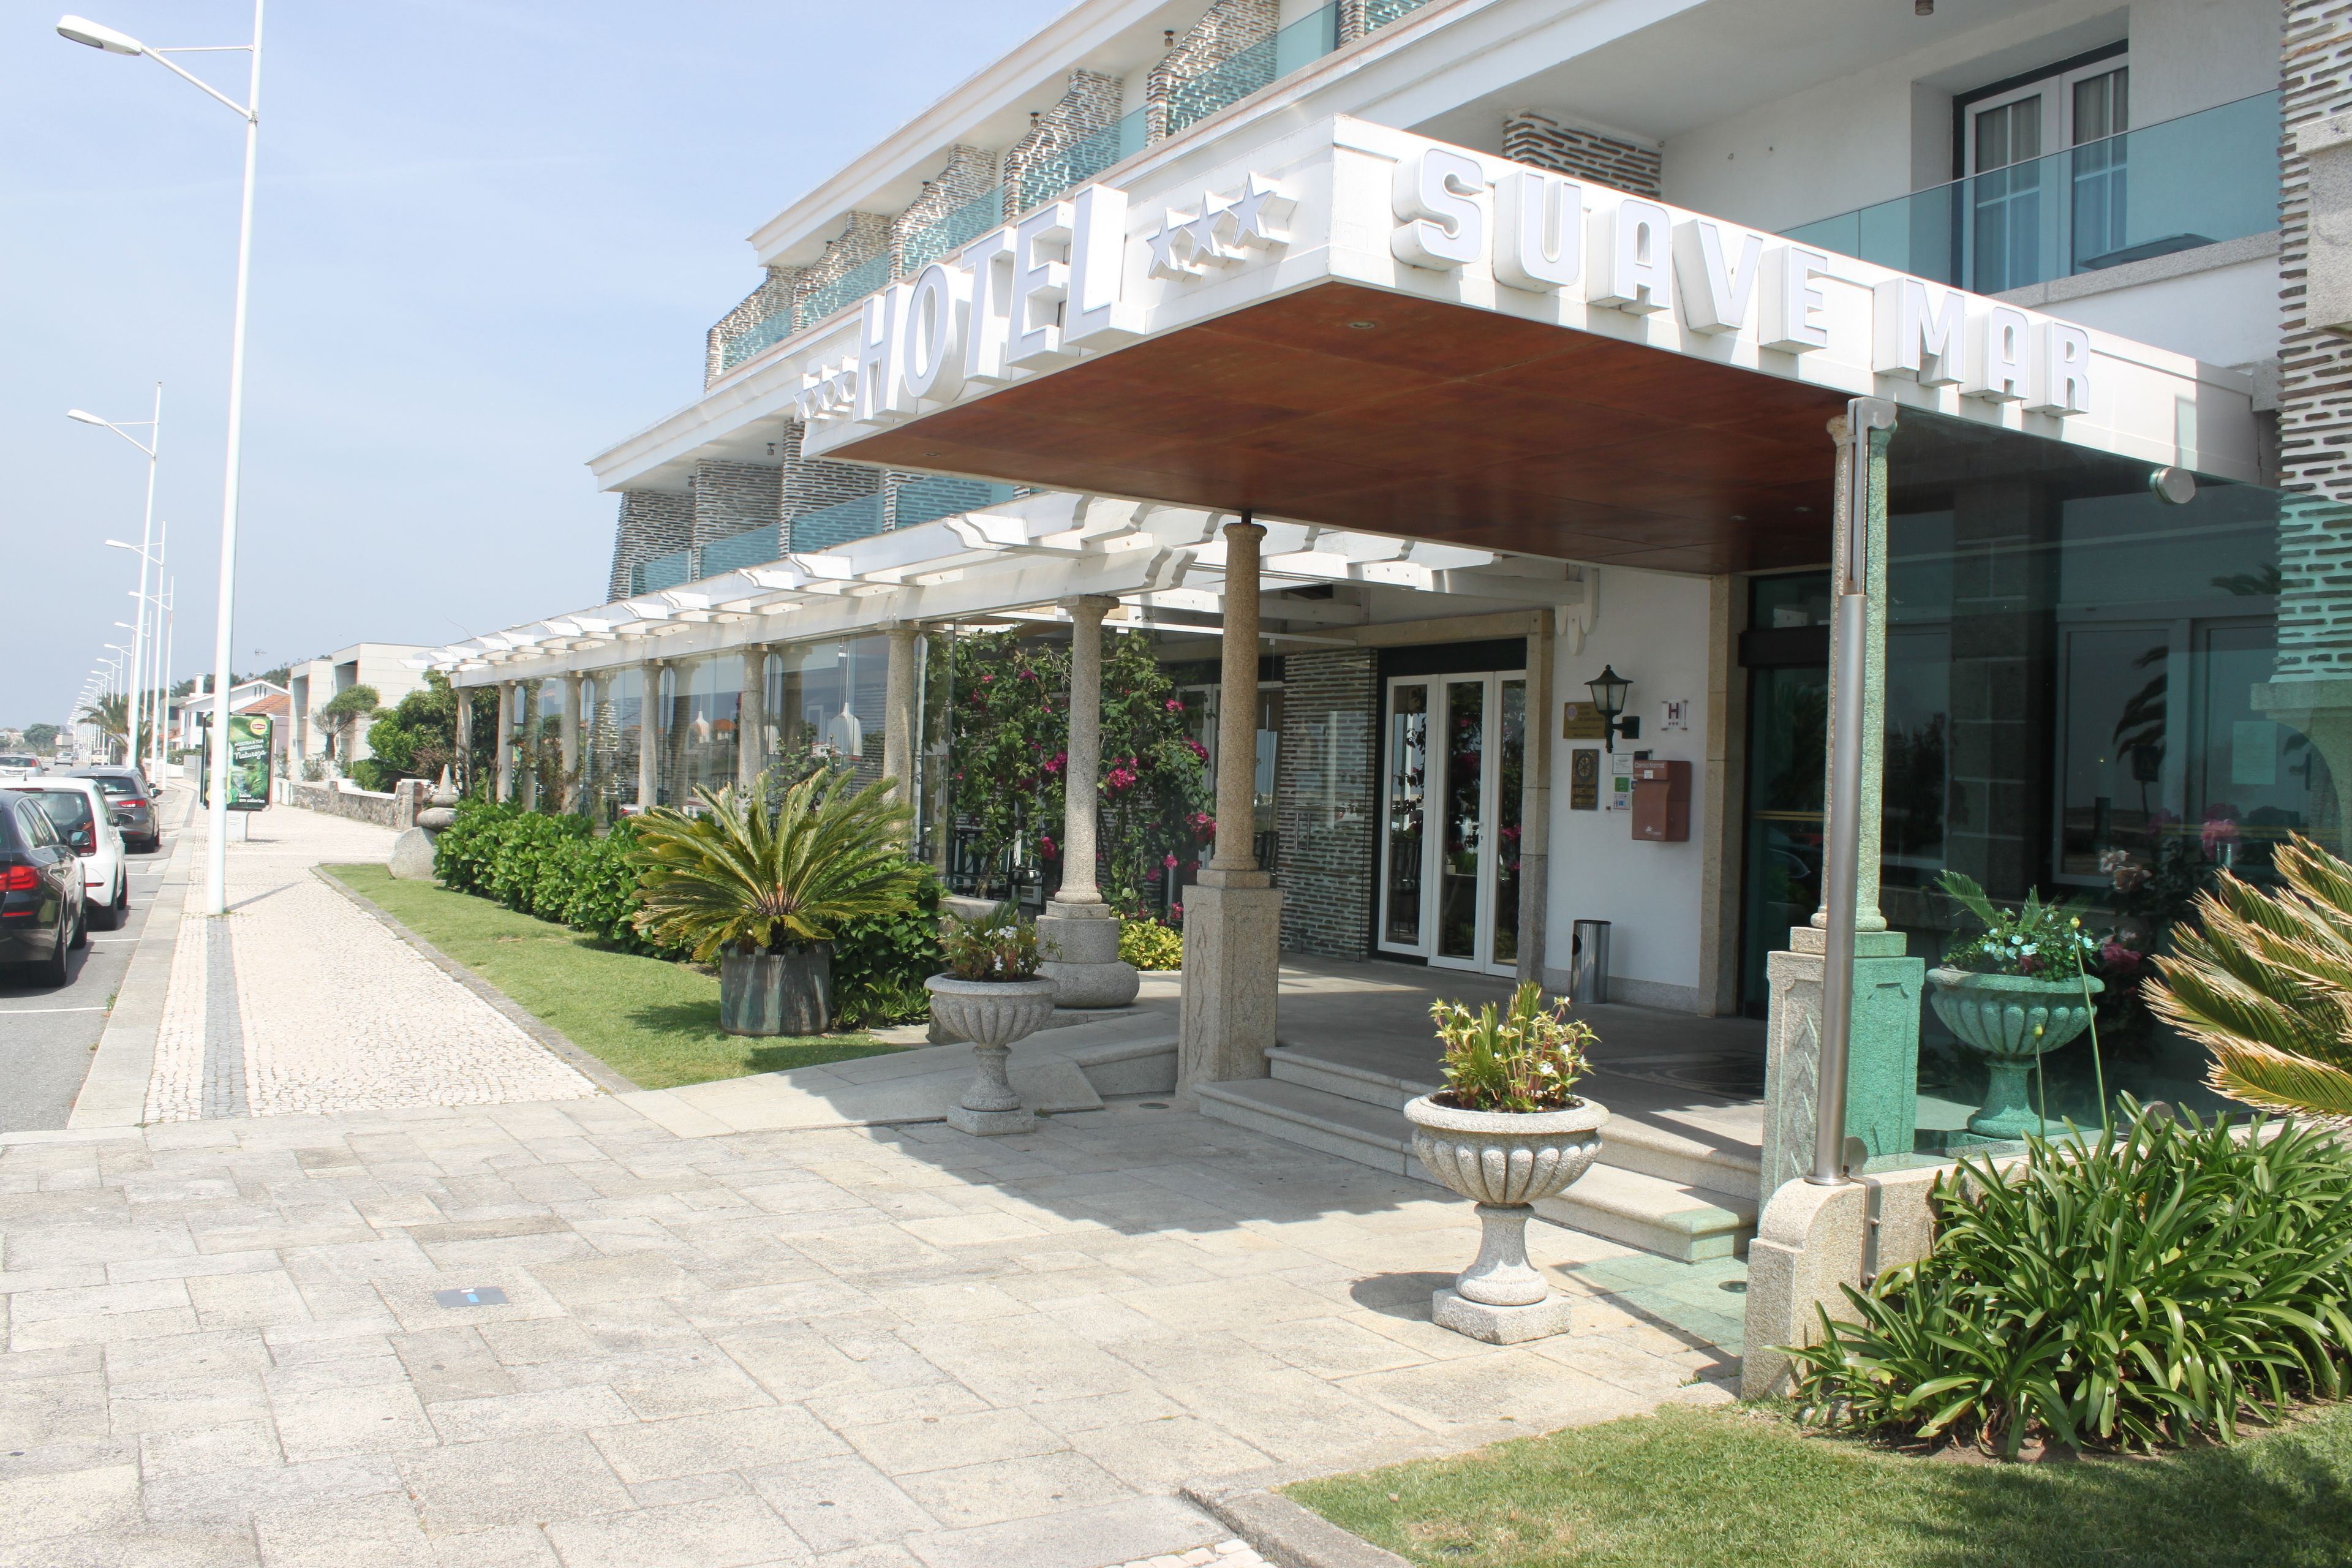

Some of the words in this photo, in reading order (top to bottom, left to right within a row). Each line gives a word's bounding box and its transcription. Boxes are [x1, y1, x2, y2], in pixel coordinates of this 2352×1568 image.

[853, 183, 1144, 424] HOTEL
[1391, 148, 1828, 355] SUAVE
[1872, 276, 2090, 418] MAR
[234, 750, 267, 760] Natureza
[1668, 703, 1679, 719] H
